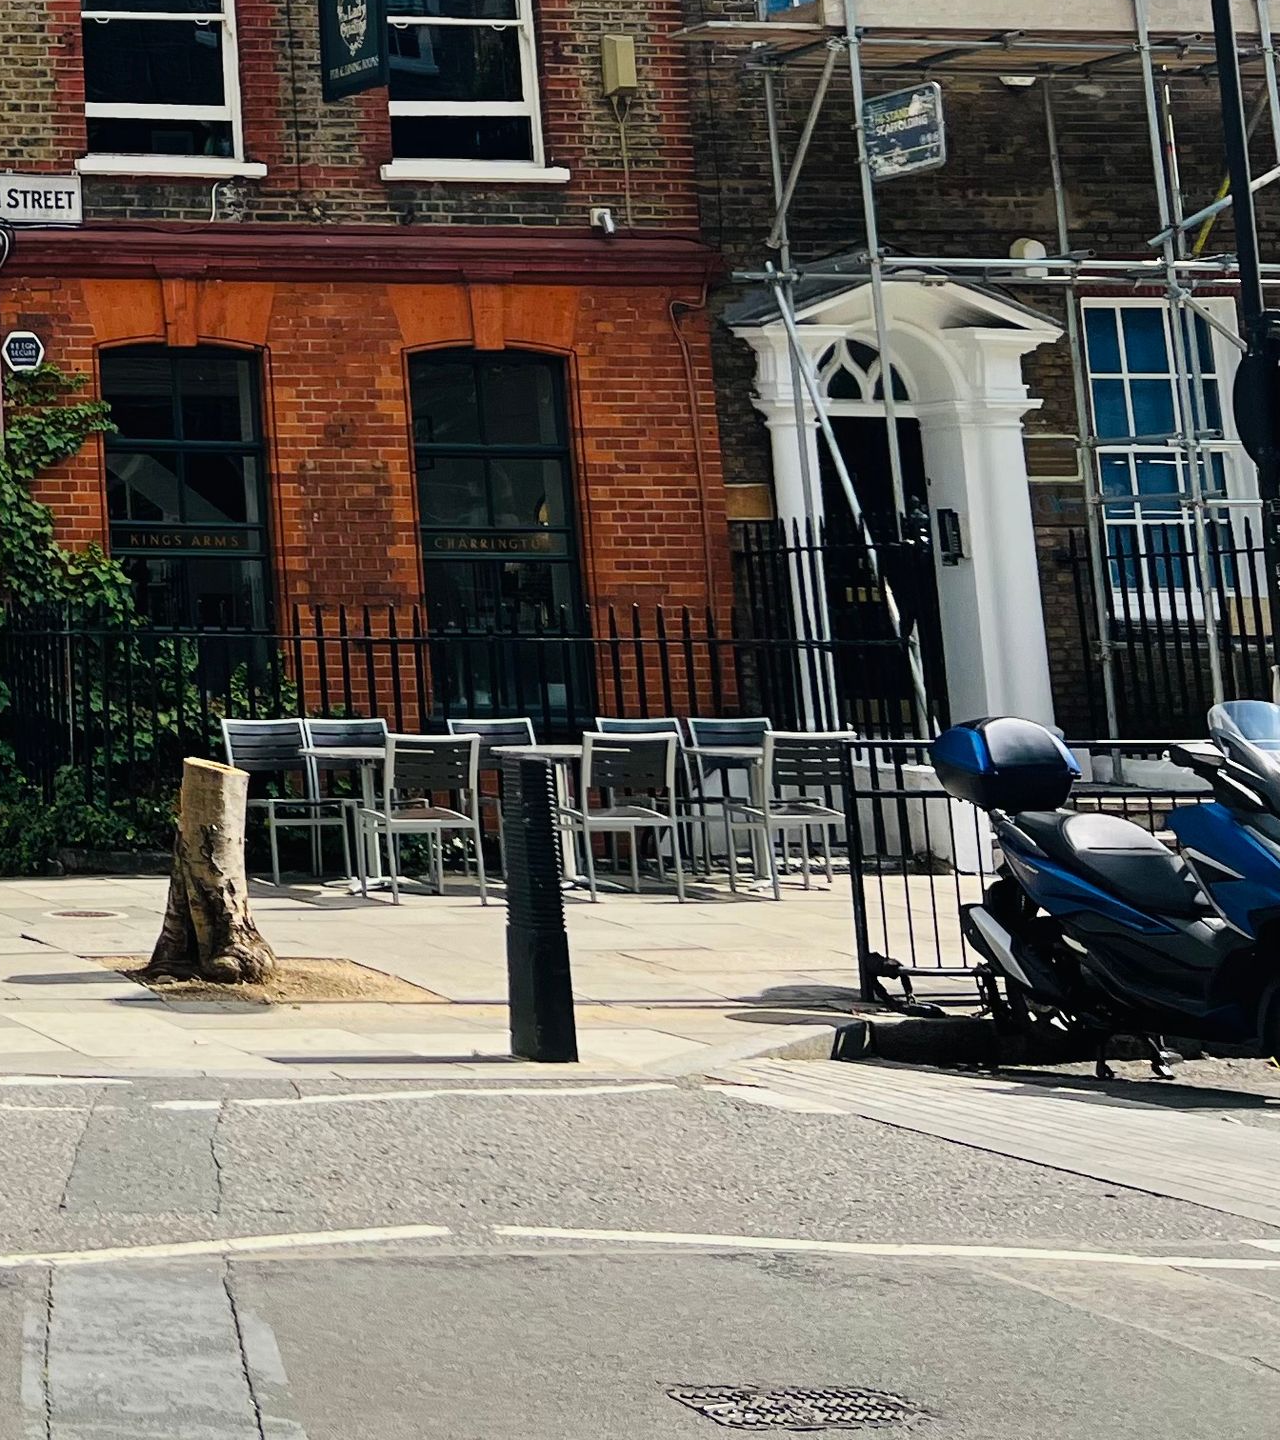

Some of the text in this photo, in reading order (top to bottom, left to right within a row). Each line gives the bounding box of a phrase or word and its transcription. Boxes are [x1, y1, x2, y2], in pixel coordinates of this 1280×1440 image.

[6, 188, 75, 209] STREET
[130, 534, 240, 547] KINGS ARMS
[434, 537, 548, 550] CHARRINGTO
